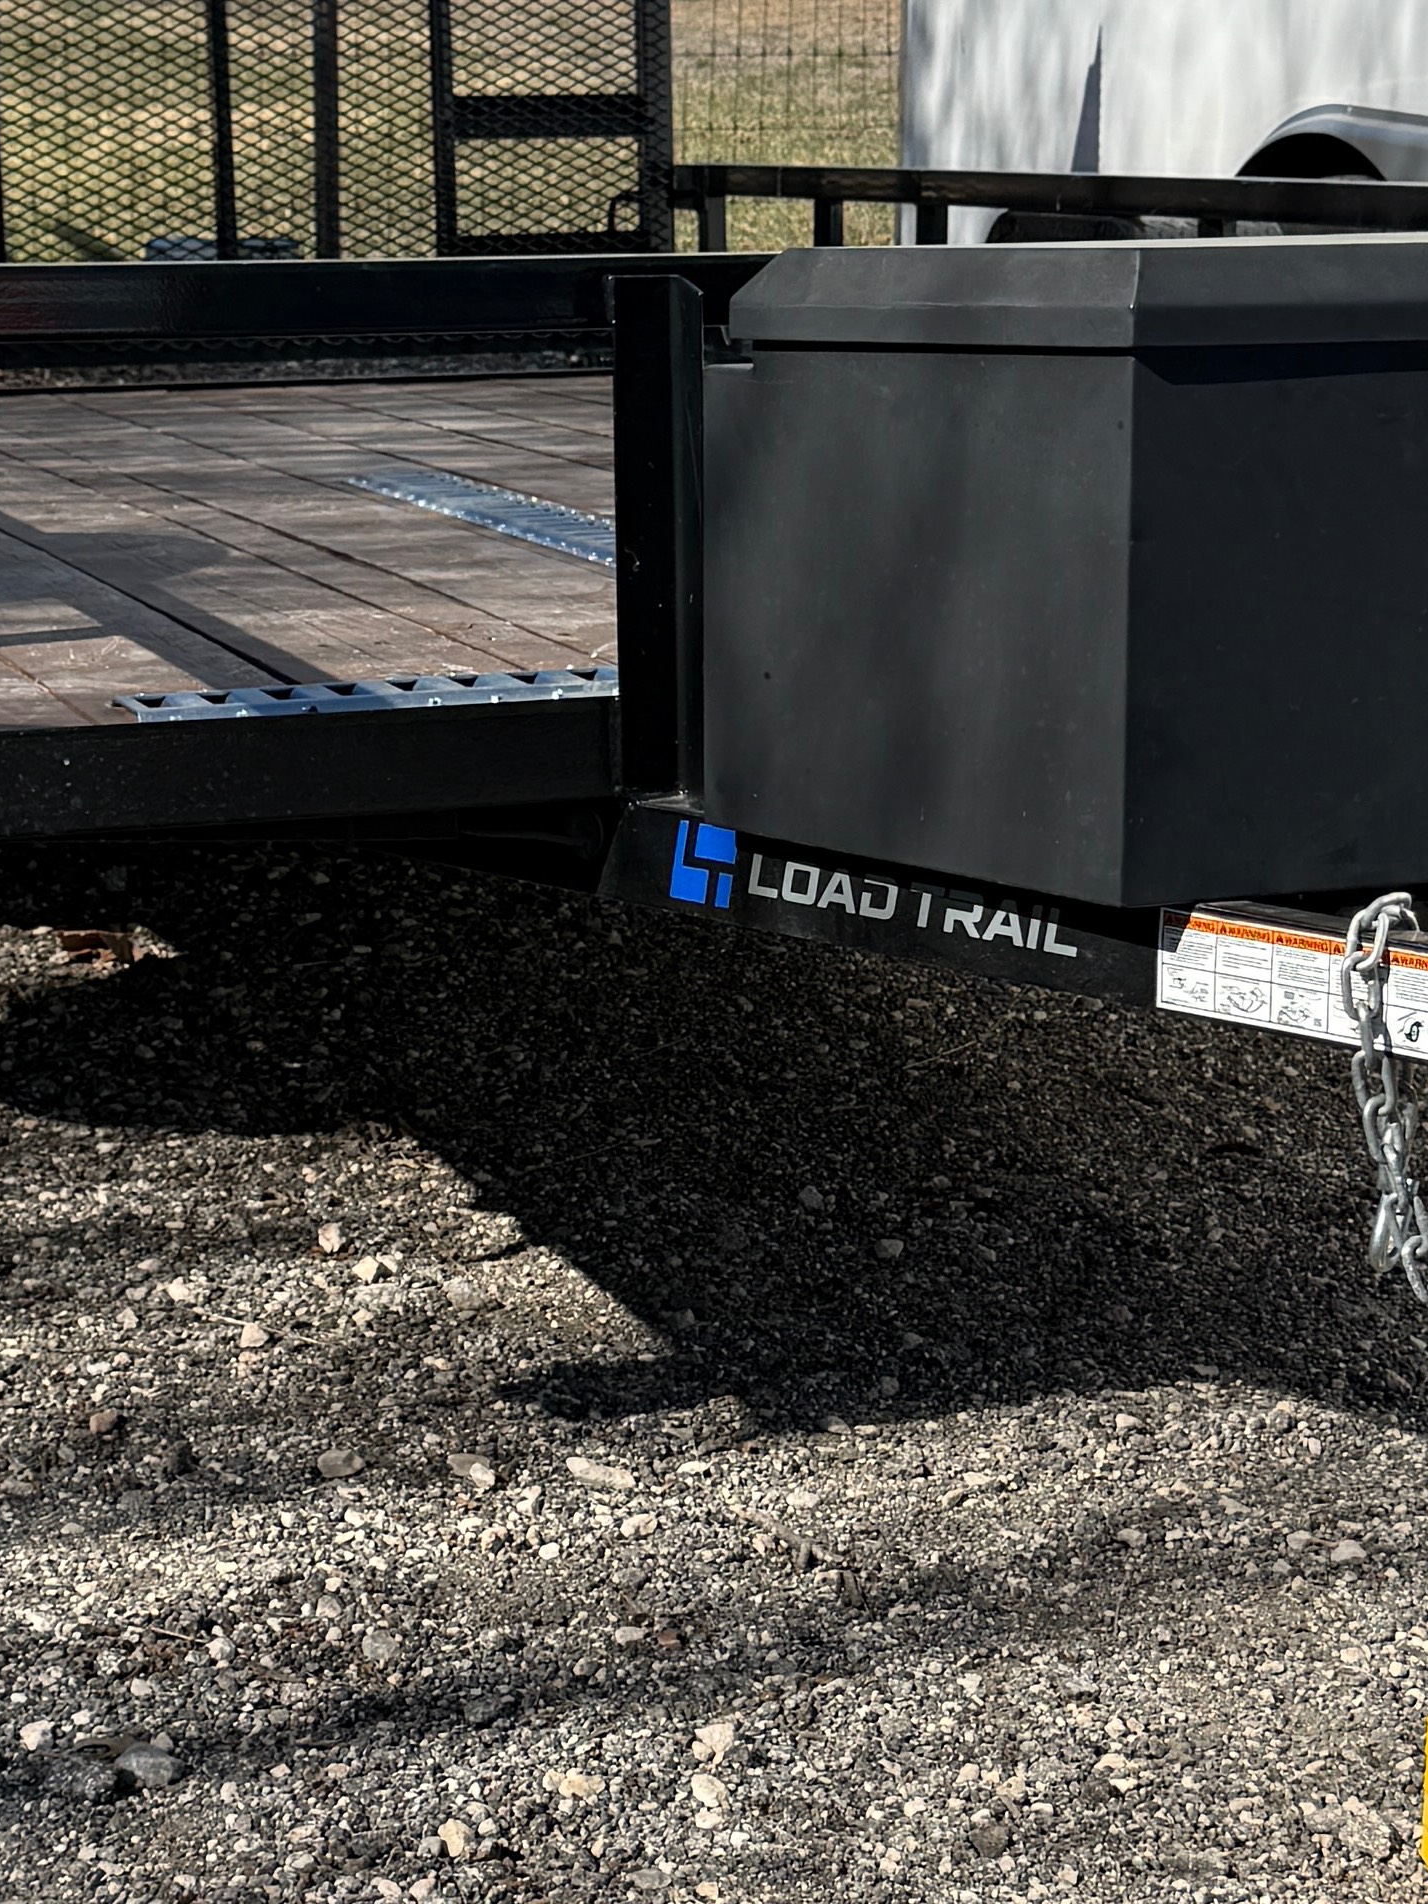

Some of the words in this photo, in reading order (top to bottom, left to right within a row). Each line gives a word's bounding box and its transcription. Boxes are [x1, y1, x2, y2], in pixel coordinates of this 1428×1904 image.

[748, 853, 899, 920] LOAD
[910, 881, 1078, 958] TRAIL
[1285, 935, 1330, 952] WARNING
